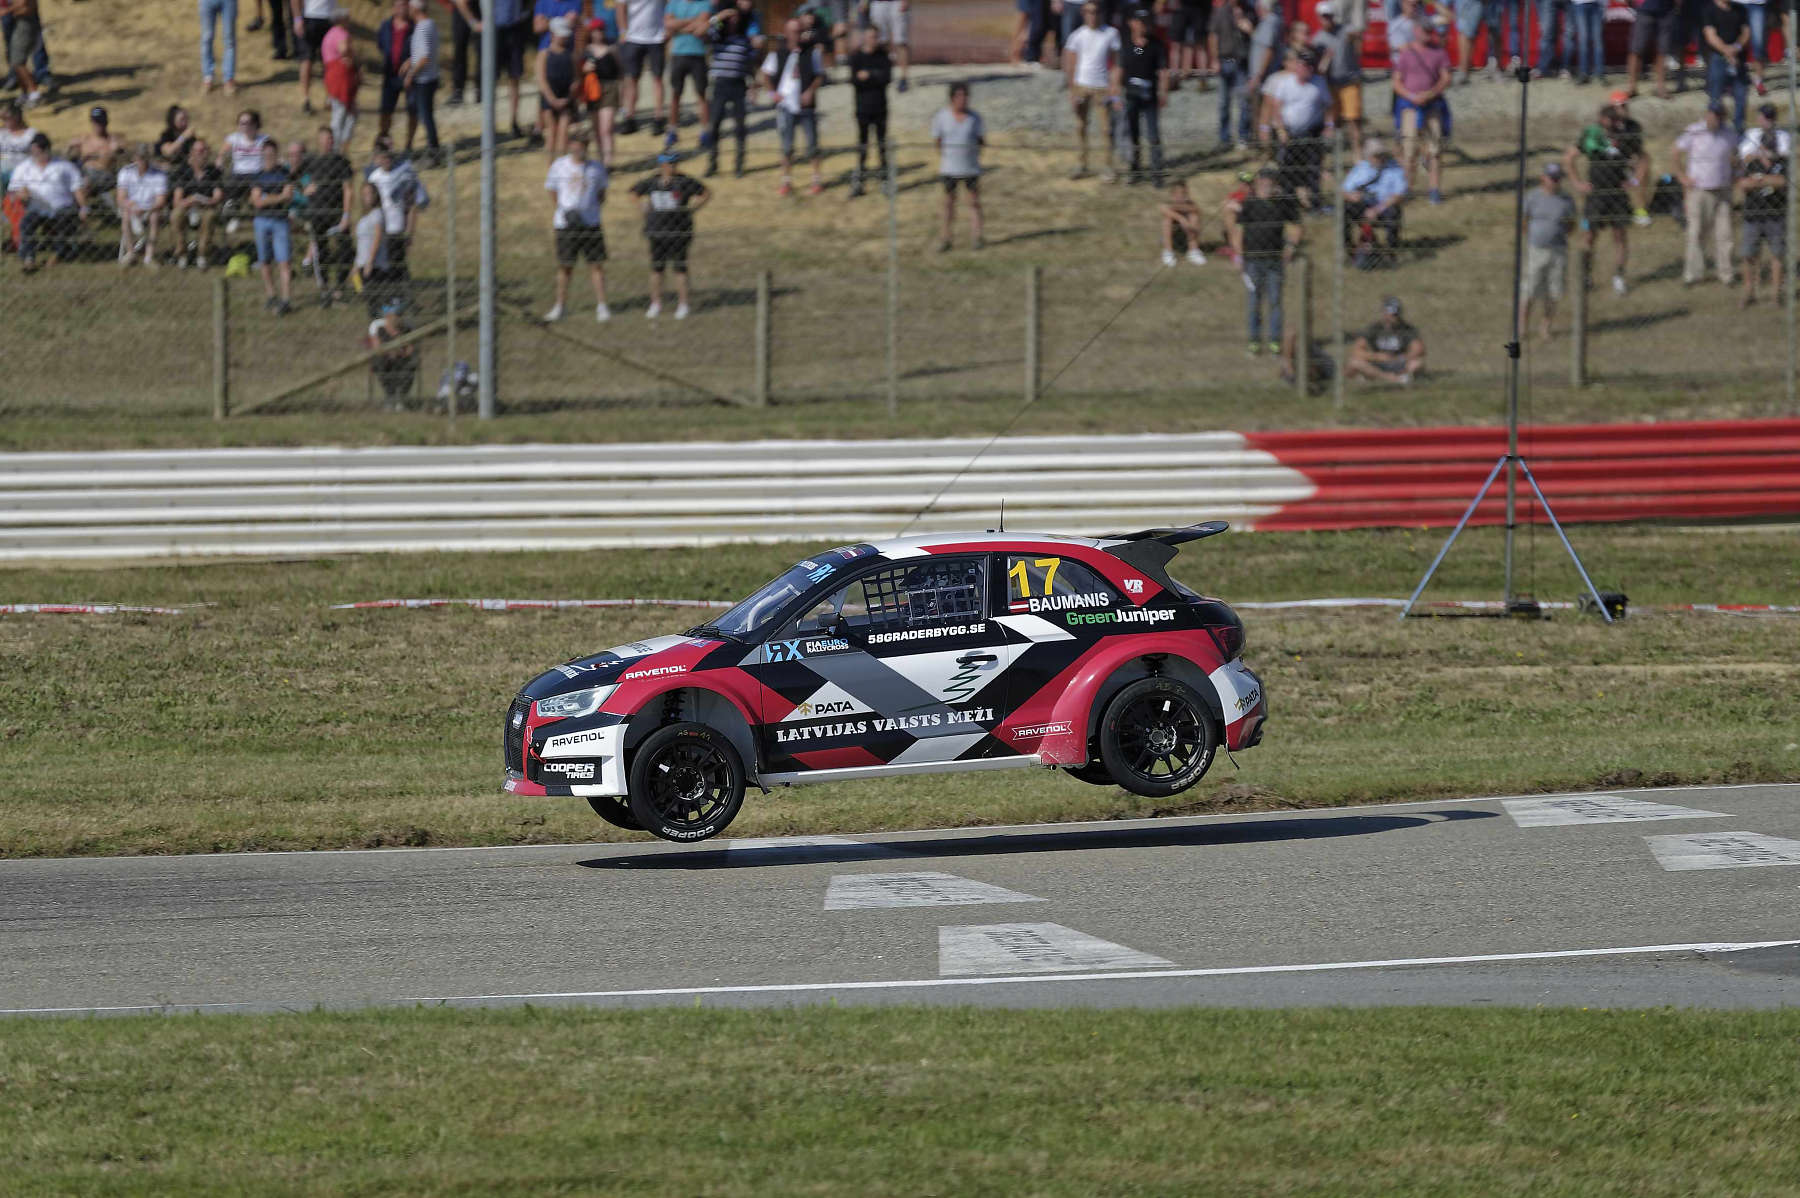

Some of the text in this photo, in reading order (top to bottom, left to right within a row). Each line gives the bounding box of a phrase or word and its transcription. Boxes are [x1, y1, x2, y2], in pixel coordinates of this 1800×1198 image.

[1008, 557, 1061, 597] 17
[1029, 592, 1109, 612] BAUMANIS
[1066, 608, 1176, 625] GreenJuniper
[868, 623, 986, 645] 58GRADERBYGG.SE
[807, 643, 849, 654] RALLYCROSS
[625, 664, 687, 680] RAVENOL
[1245, 688, 1259, 707] PATA
[815, 700, 854, 715] PATA
[777, 708, 994, 743] LATVIJAS VALSTS MEŽI
[1018, 725, 1067, 737] RAVENOL
[552, 732, 605, 748] RAVENOL
[543, 763, 595, 773] COOPER
[565, 771, 594, 779] TIRES
[662, 826, 715, 839] COOPER
